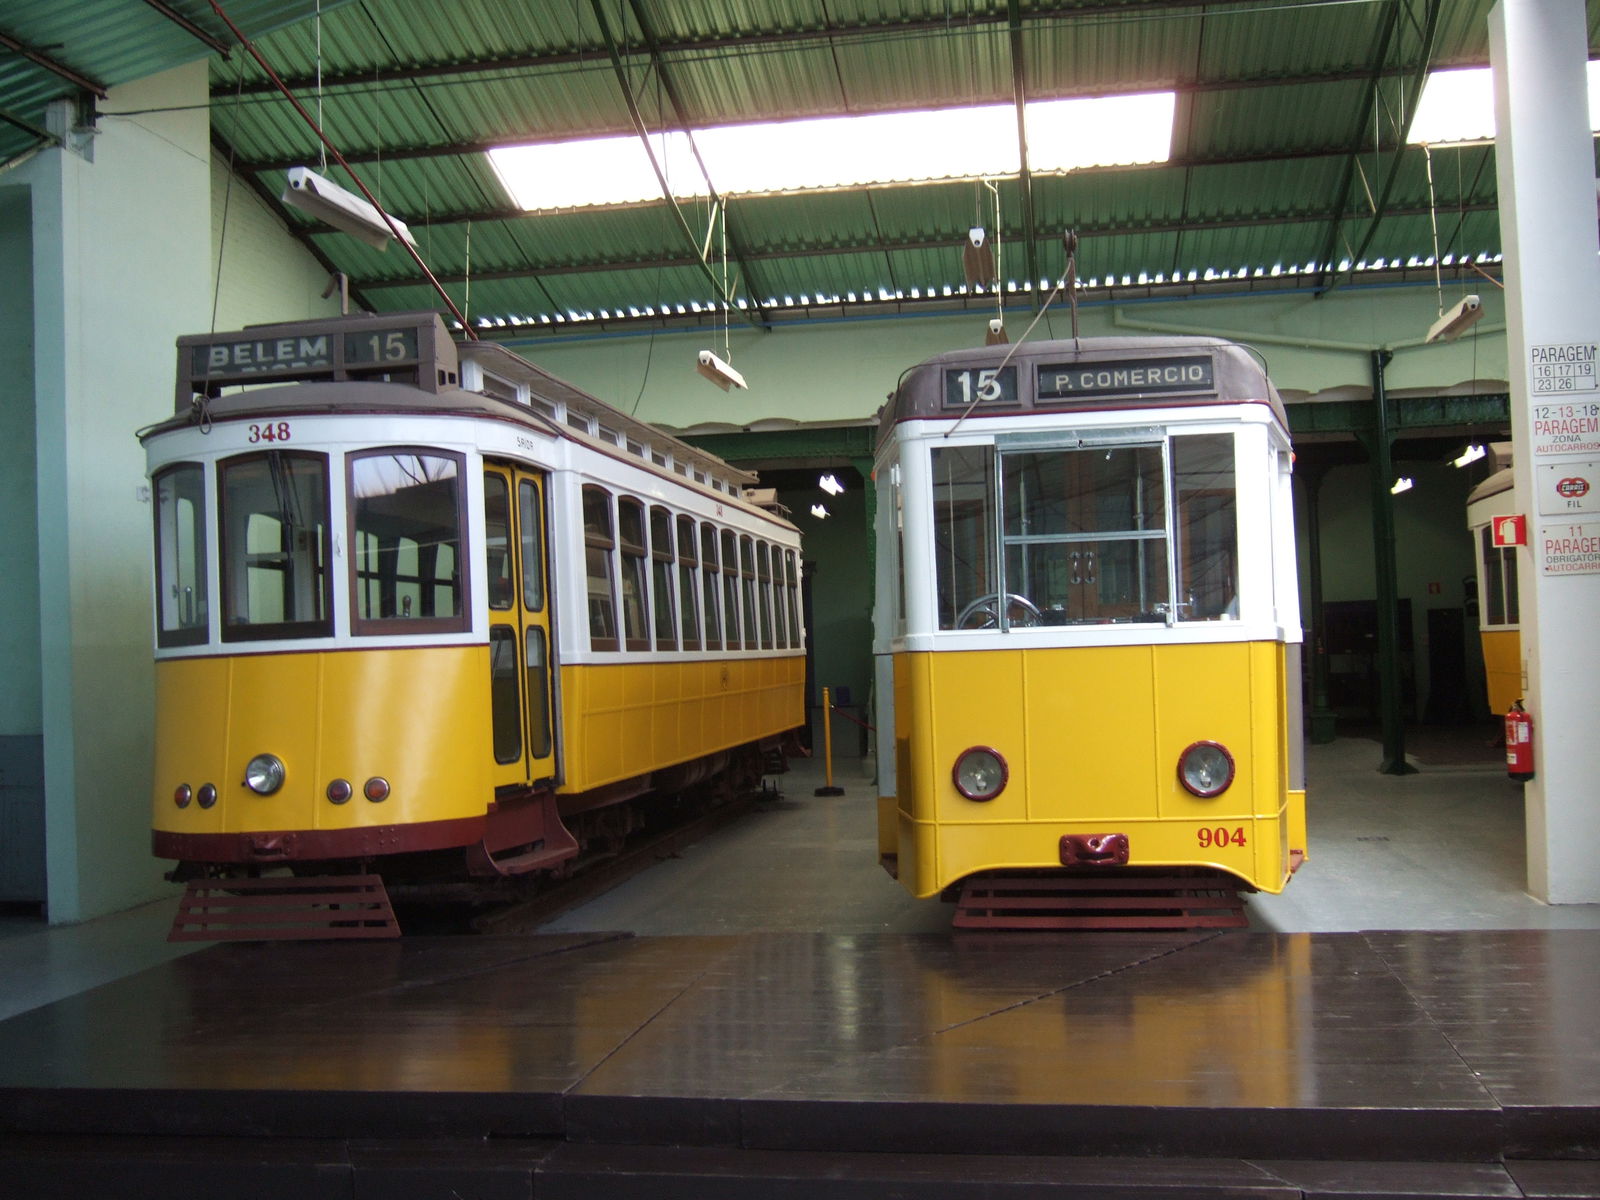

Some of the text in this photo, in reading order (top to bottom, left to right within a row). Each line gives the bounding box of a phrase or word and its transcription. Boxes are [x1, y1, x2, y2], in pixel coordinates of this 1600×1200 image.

[209, 332, 406, 367] BELEM 15
[1532, 345, 1596, 363] PARAGEM
[1538, 363, 1591, 377] 16 17 19
[957, 365, 1203, 402] 15 P. COMERCIO
[1538, 378, 1572, 391] 23 26
[248, 422, 291, 444] 348
[1535, 418, 1599, 436] PARAGEM
[1536, 442, 1600, 453] AUTOCARROS
[1552, 434, 1582, 444] ZONA
[1567, 500, 1582, 508] FIL
[1569, 526, 1583, 537] 11
[1545, 537, 1600, 555] PARAGE
[1197, 826, 1247, 848] 904
